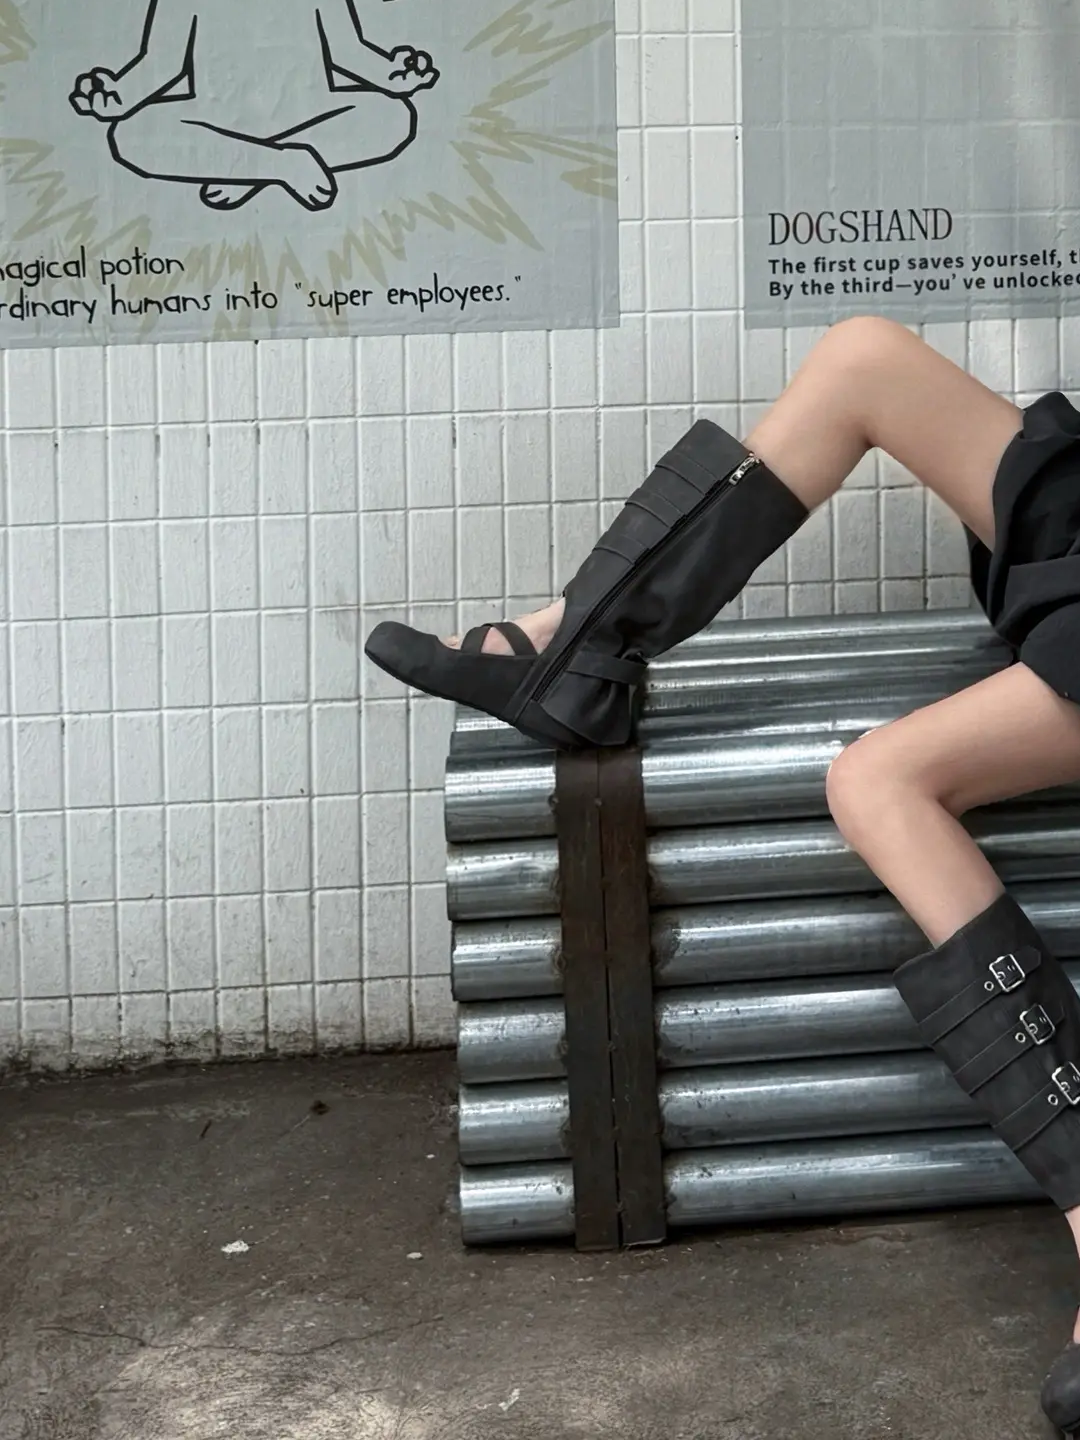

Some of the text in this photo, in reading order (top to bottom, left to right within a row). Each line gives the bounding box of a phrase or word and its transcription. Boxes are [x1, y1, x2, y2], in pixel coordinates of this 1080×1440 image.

[768, 208, 952, 245] DOGSHAND
[100, 247, 185, 285] potion
[768, 258, 806, 274] The
[814, 257, 856, 273] first
[864, 259, 900, 274] cup
[908, 257, 964, 270] saves
[971, 249, 1062, 272] yourself,
[111, 283, 211, 315] humans
[227, 281, 277, 310] into
[770, 281, 793, 300] By
[801, 279, 834, 295] the
